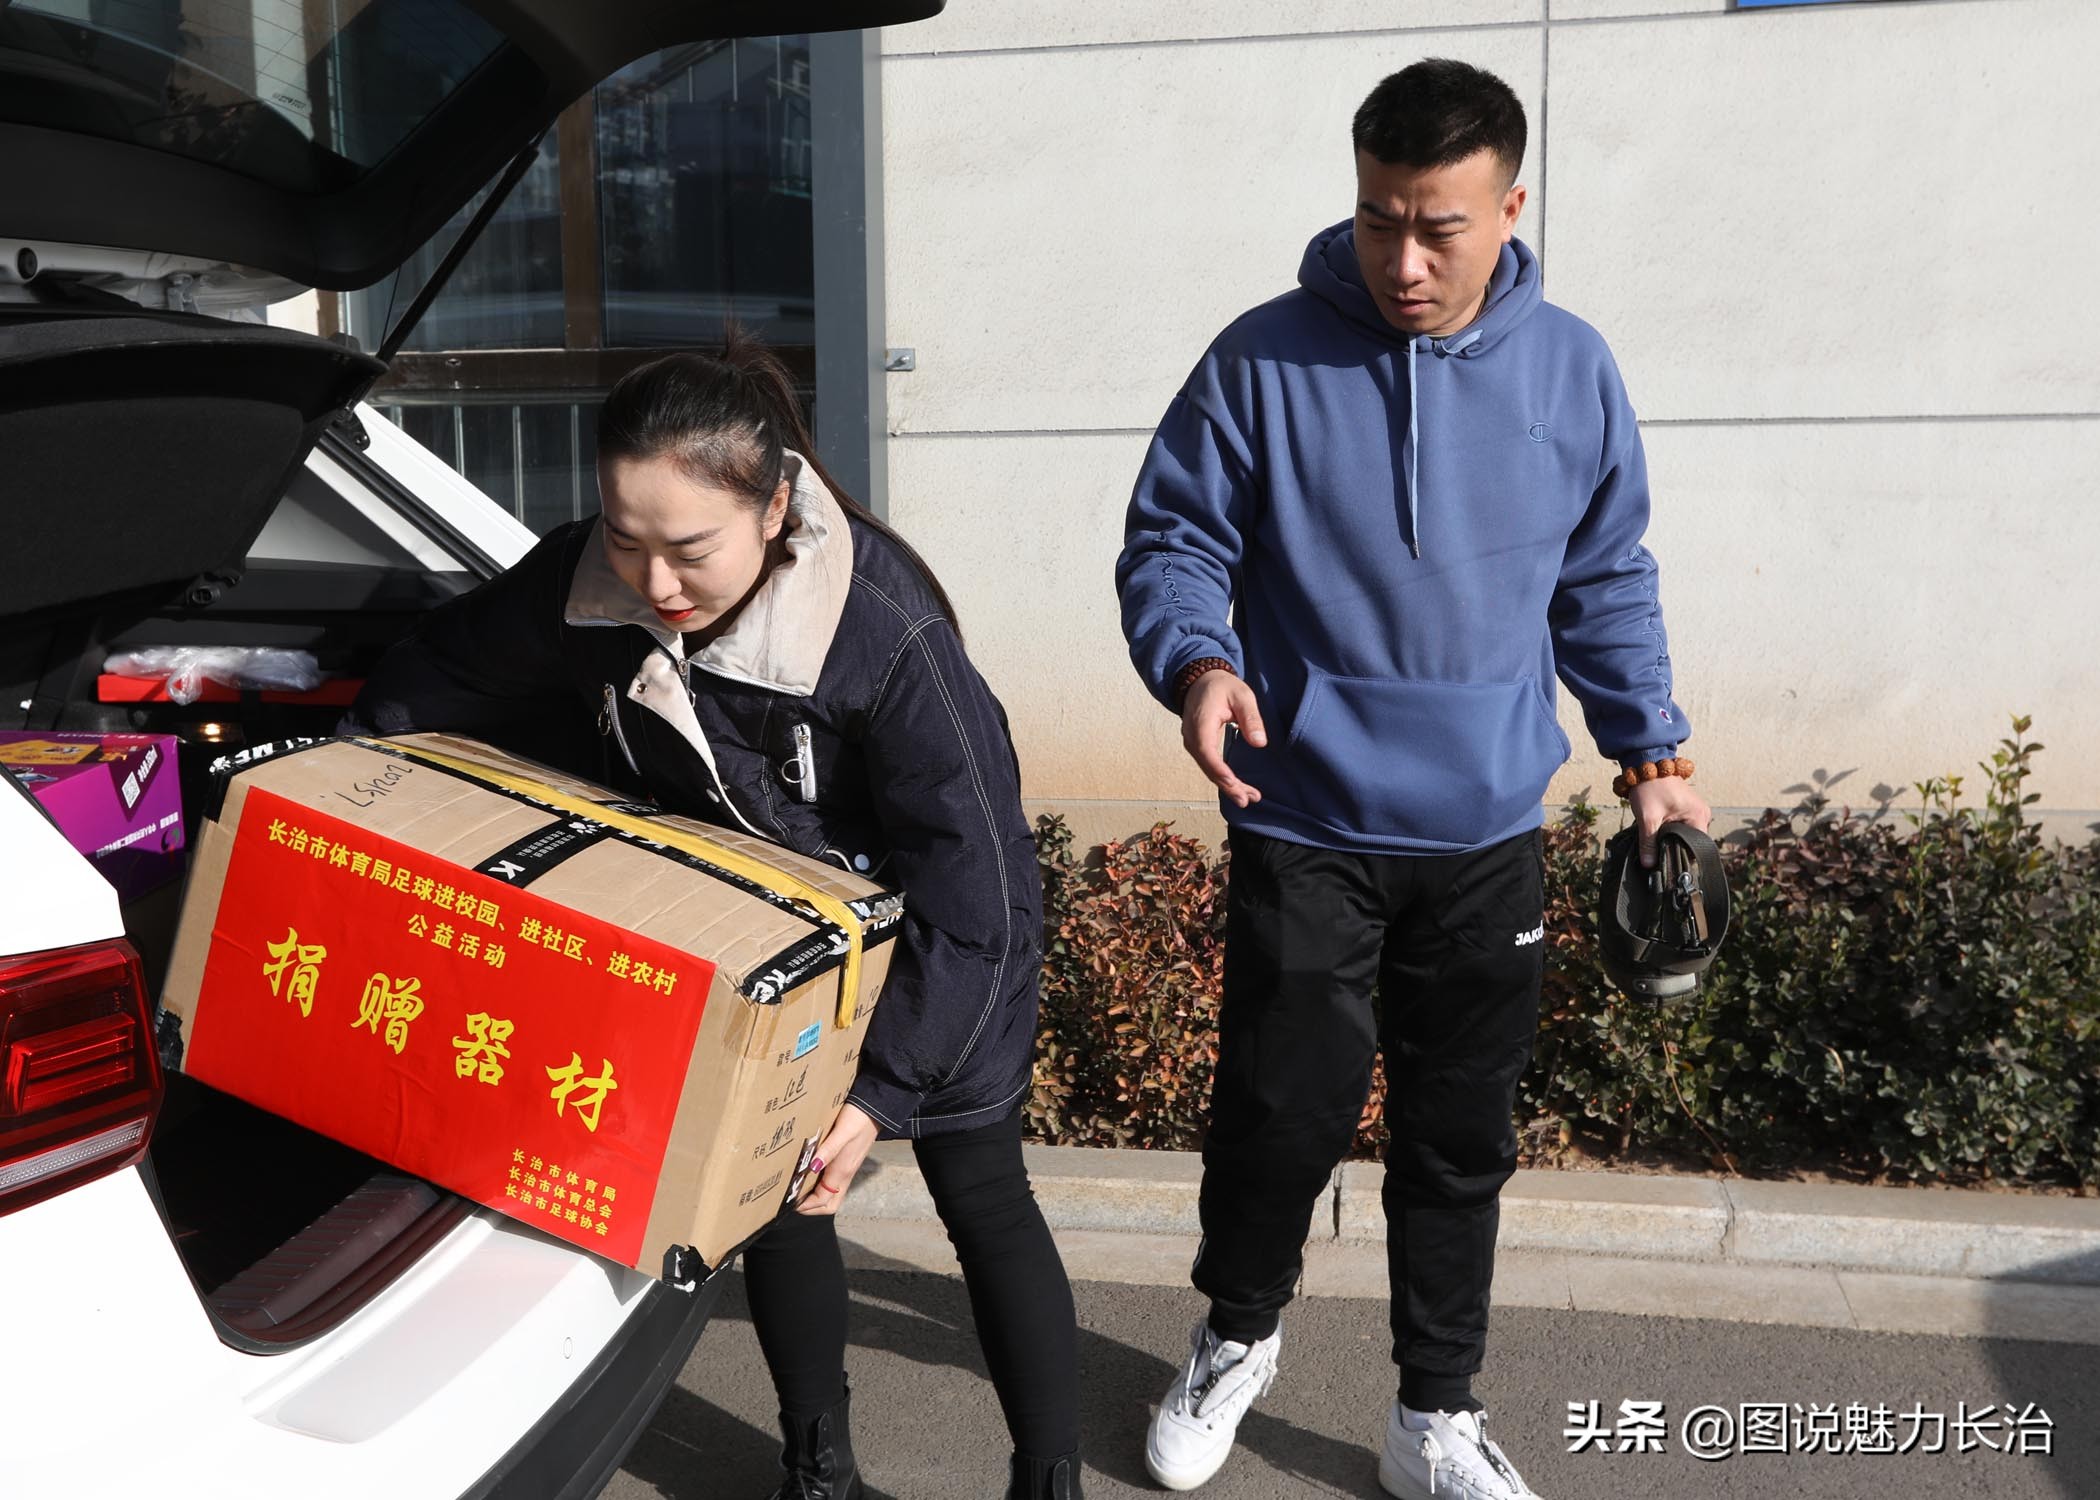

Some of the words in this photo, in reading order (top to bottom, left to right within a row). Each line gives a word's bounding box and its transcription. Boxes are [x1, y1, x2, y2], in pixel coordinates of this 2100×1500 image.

[268, 818, 678, 997] 长治市体育局足球进校园、进社区、进农村
[408, 914, 507, 969] 公益活动
[263, 926, 618, 1133] 捐赠器材
[508, 1165, 613, 1219] 长治市体育总会
[512, 1148, 616, 1202] 长治市体育局
[505, 1182, 609, 1237] 长治市足球协会
